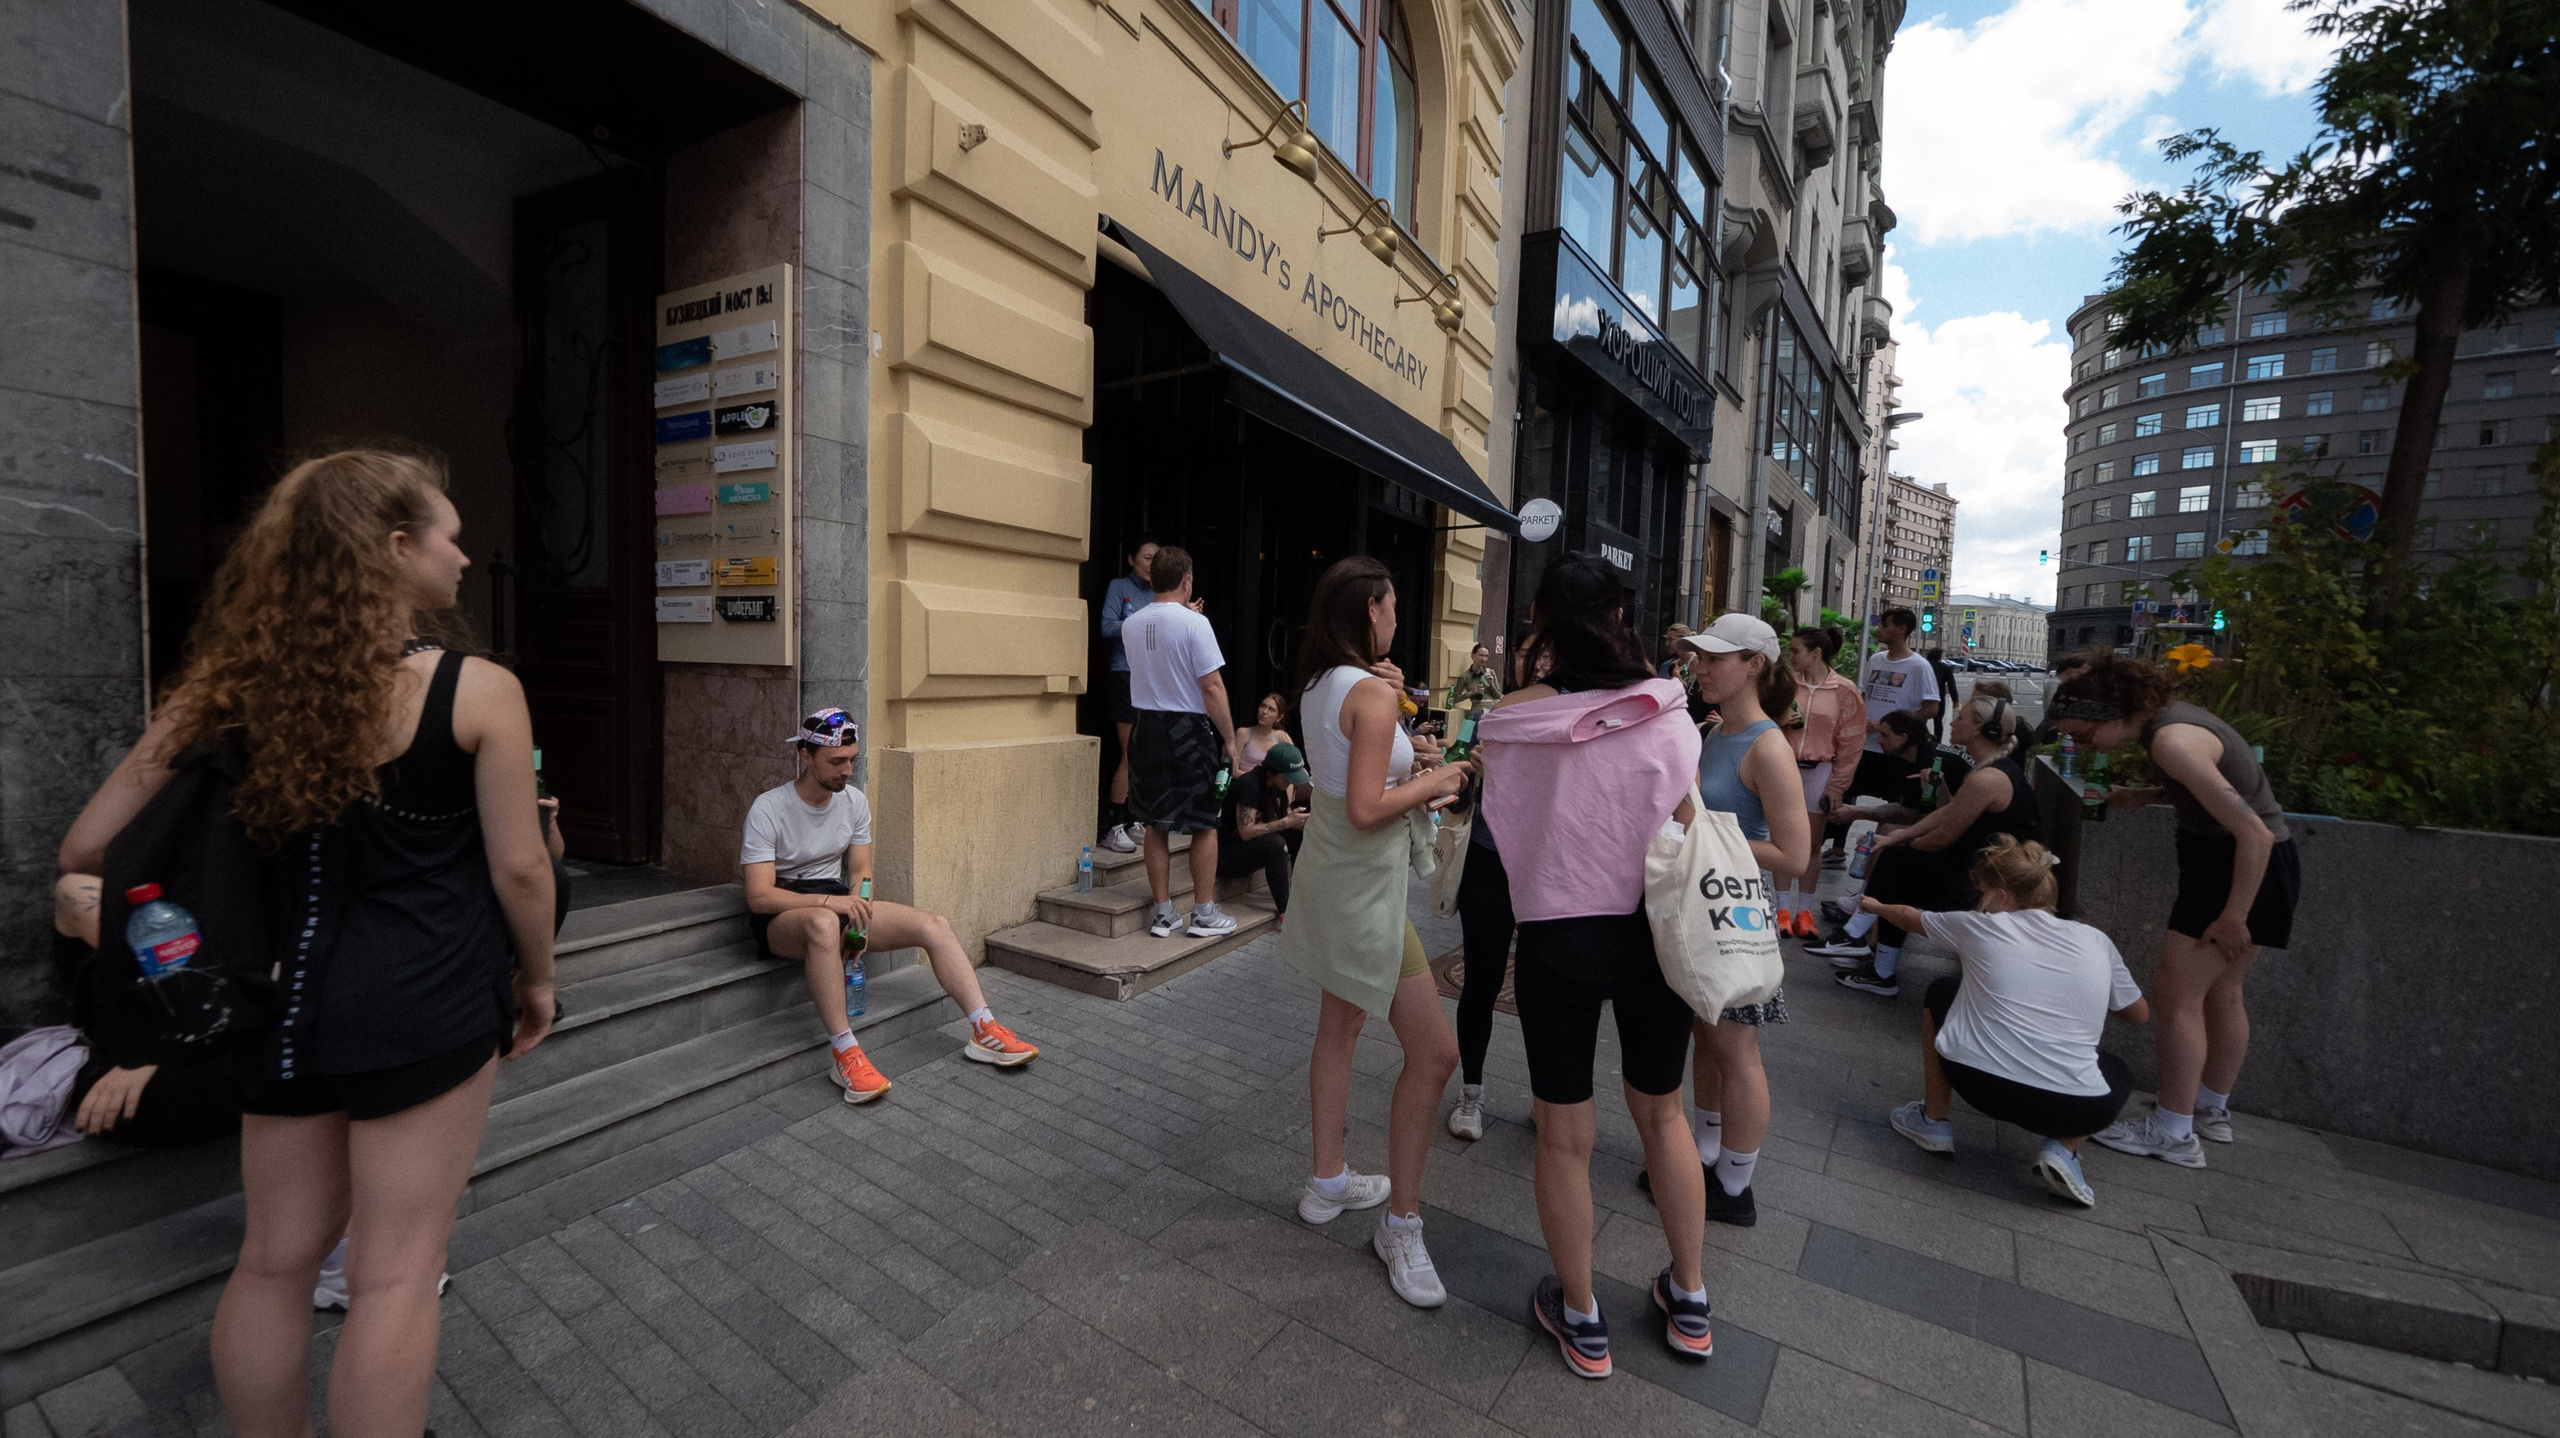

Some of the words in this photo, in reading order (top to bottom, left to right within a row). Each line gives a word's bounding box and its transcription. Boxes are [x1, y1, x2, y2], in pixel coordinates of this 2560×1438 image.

[666, 292, 722, 326] КУЗНЕЦКИЙ
[725, 288, 752, 313] МОСТ
[1301, 272, 1428, 391] APOTHECARY
[1599, 309, 1671, 404] ХОРОШИЙ
[1673, 379, 1697, 427] ПОЛ
[1521, 514, 1556, 525] PARKET
[1601, 543, 1633, 571] PARKET
